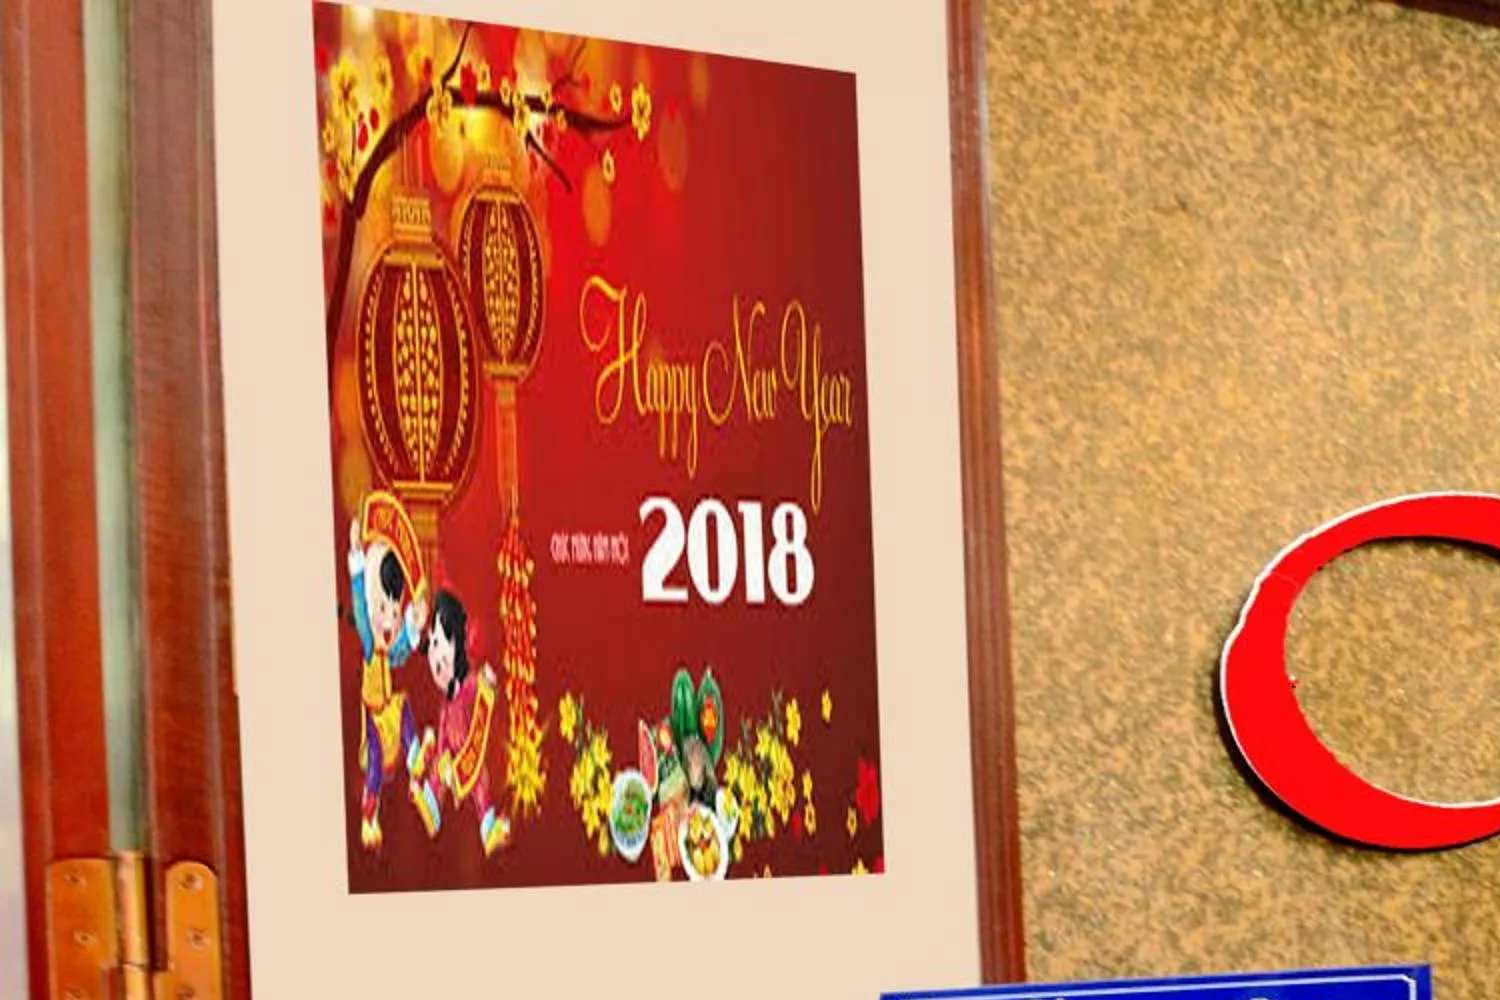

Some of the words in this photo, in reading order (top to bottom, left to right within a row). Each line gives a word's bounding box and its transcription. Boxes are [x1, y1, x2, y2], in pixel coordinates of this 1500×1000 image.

[579, 275, 698, 480] Happy
[703, 294, 777, 425] New
[780, 299, 853, 517] Year
[638, 495, 815, 605] 2018
